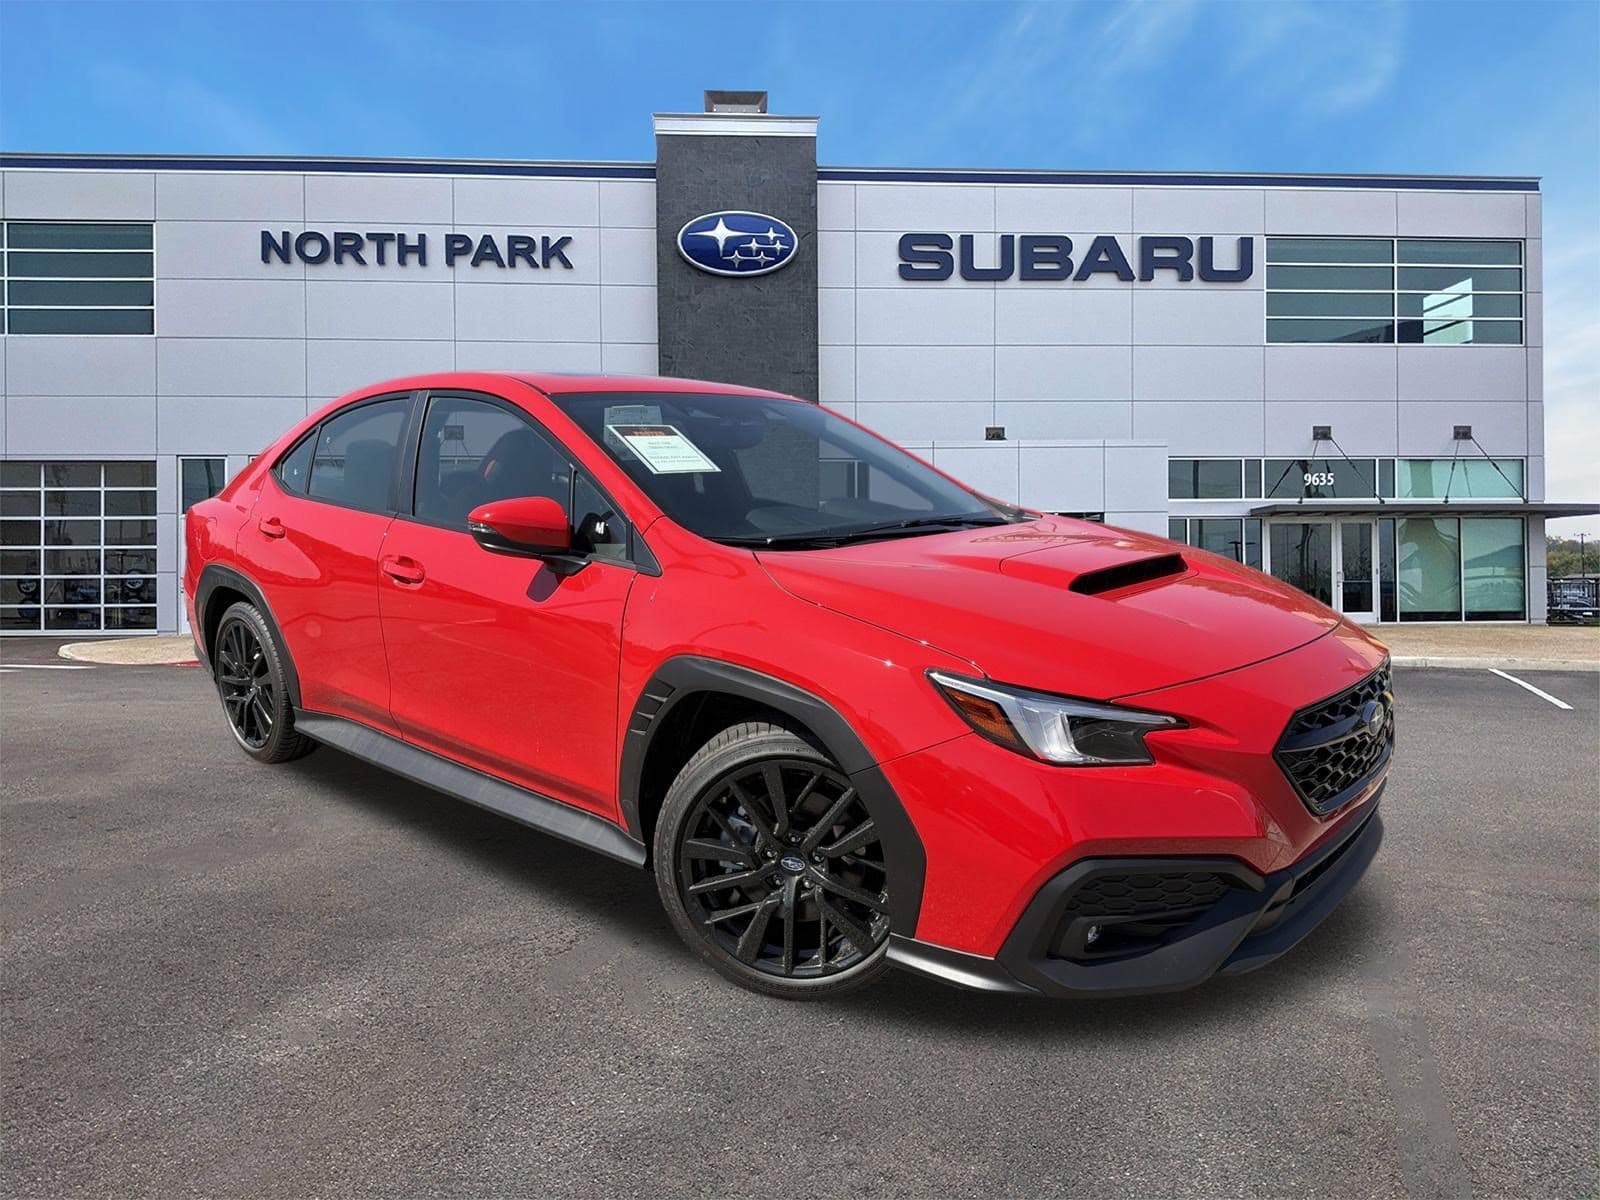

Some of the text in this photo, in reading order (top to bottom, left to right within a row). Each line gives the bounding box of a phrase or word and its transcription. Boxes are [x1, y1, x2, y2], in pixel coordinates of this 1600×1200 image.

[260, 230, 574, 269] NORTH PARK
[898, 232, 1254, 282] SUBARU
[1303, 473, 1335, 486] 9635
